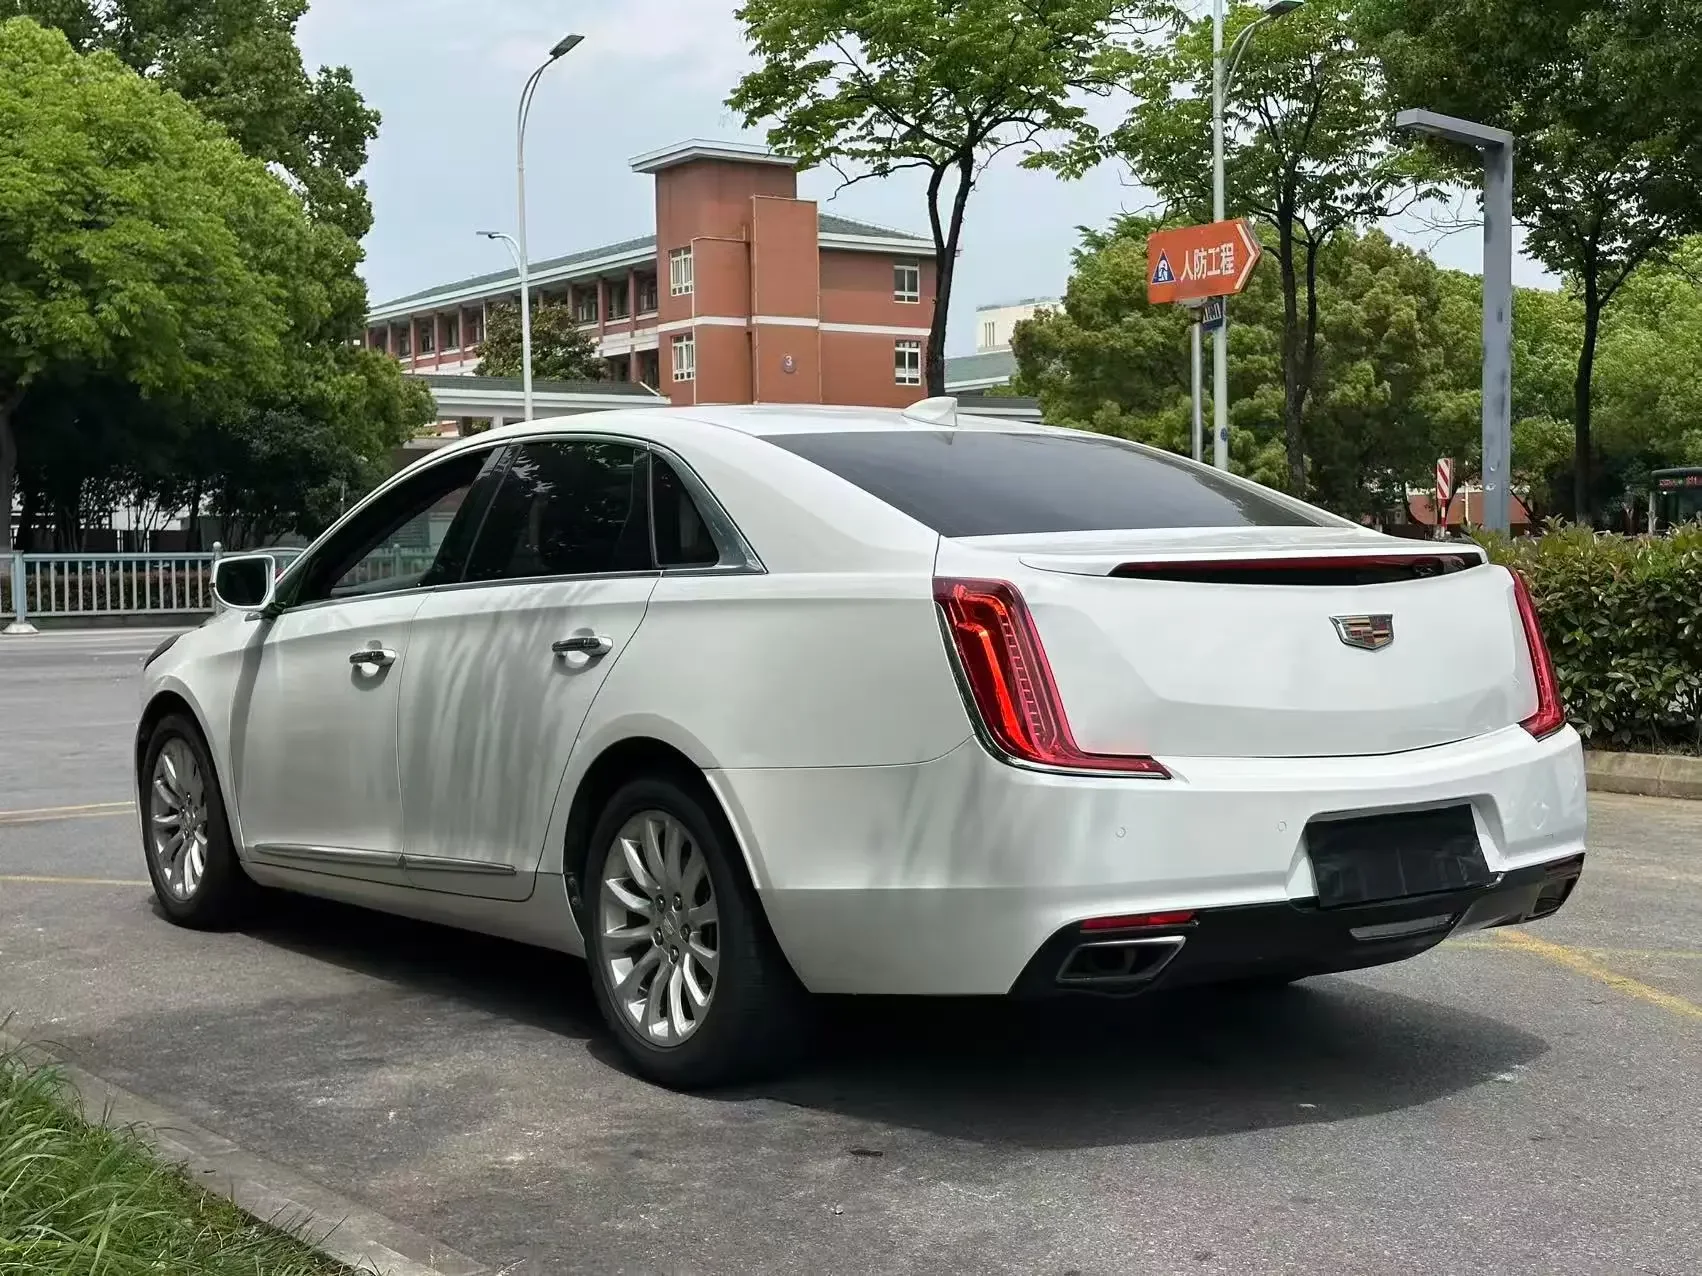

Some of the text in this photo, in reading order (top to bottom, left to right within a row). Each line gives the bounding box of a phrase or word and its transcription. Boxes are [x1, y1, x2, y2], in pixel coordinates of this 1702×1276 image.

[1180, 243, 1234, 281] 人防工程
[785, 355, 792, 366] 3
